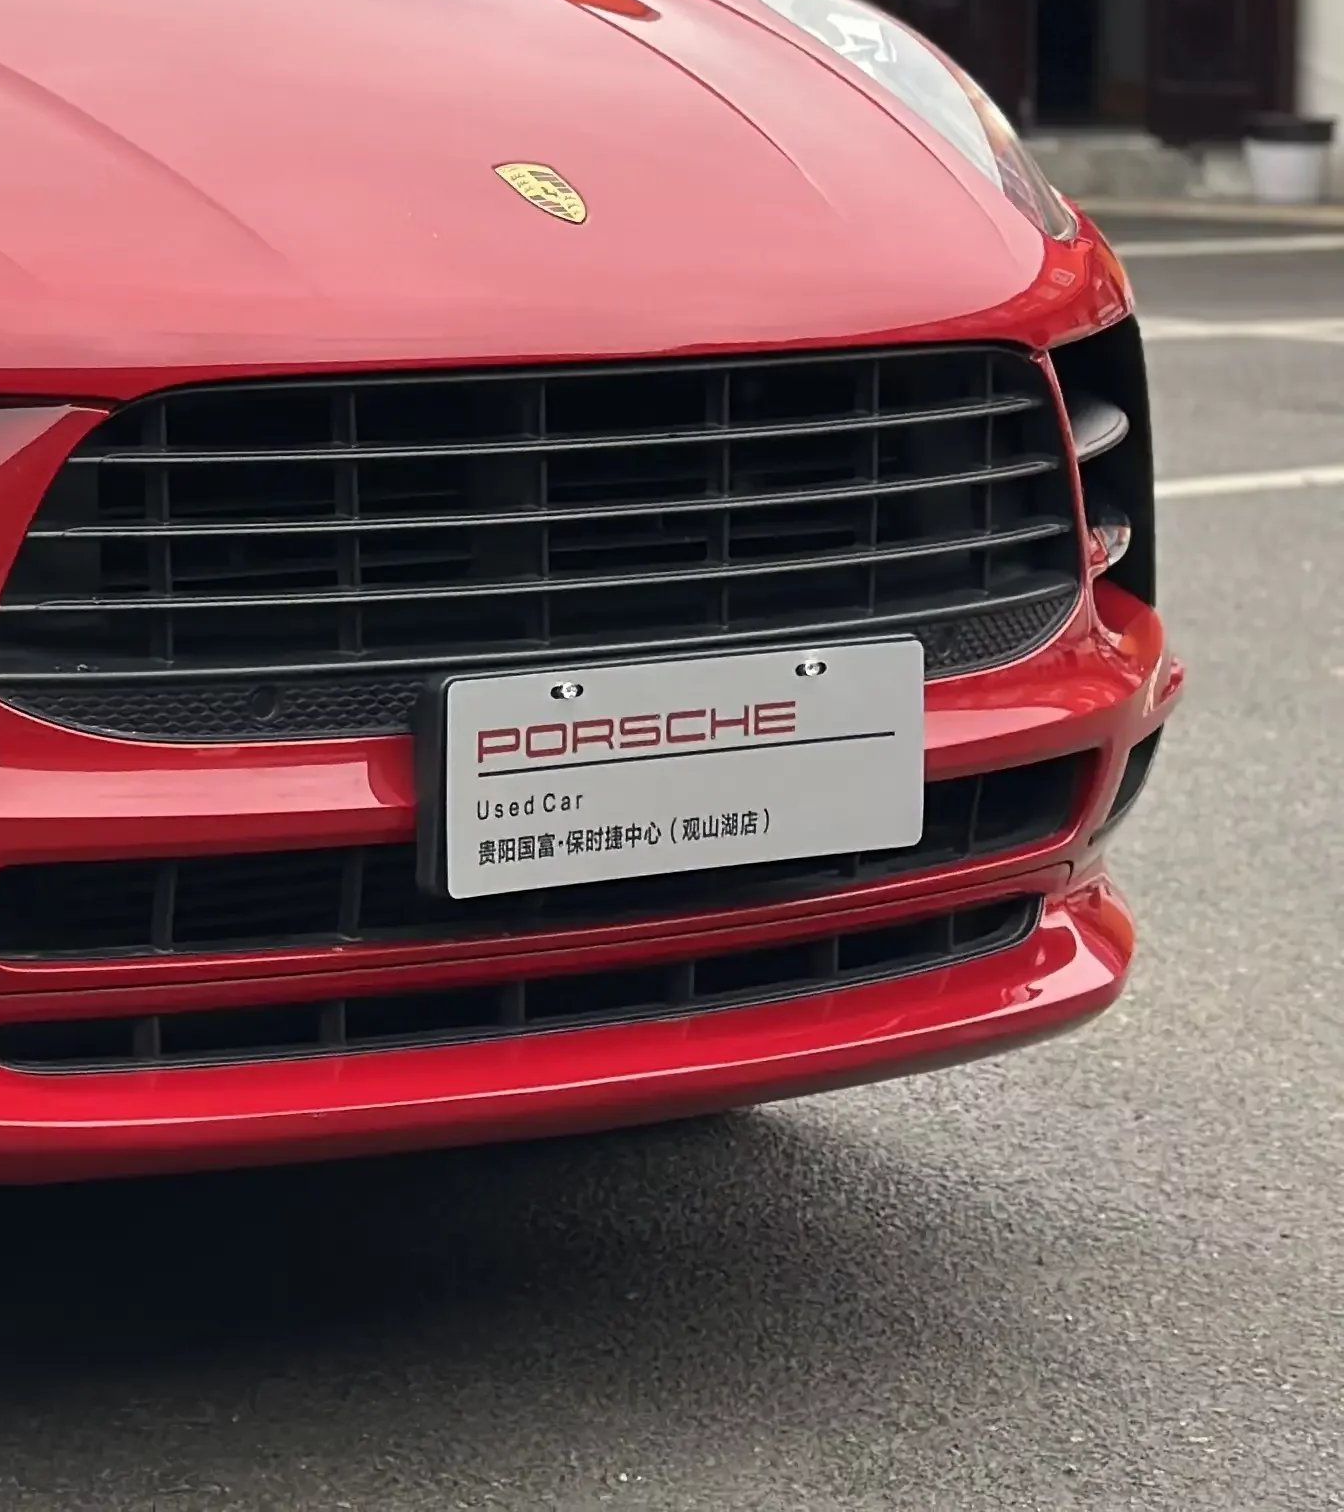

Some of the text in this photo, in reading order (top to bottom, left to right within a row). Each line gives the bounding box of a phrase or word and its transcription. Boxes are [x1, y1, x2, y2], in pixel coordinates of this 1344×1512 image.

[477, 700, 797, 764] PORSCHE
[476, 792, 584, 821] Used Car
